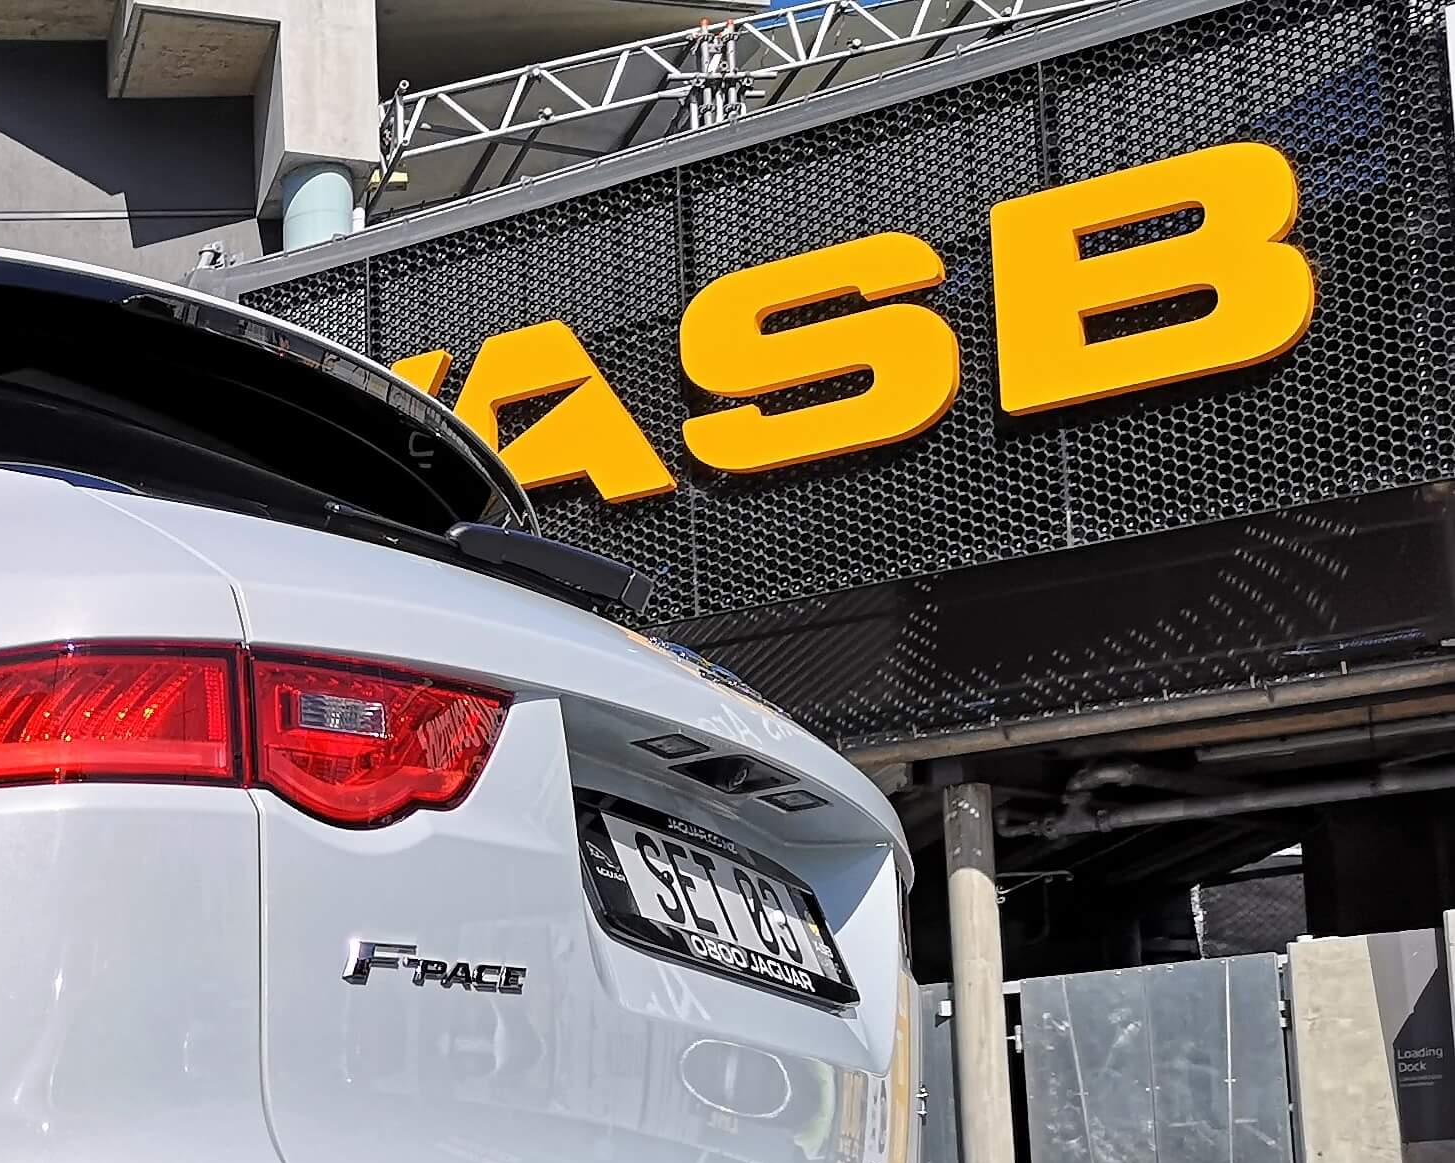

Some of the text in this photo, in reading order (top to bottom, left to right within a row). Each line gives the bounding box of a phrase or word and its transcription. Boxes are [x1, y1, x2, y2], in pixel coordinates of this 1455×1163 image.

[452, 140, 1318, 504] ASB
[634, 831, 739, 942] SET
[690, 934, 748, 970] 0800
[750, 952, 816, 993] JAGUAR
[1397, 1047, 1443, 1060] Loading
[1398, 1060, 1427, 1073] Dock
